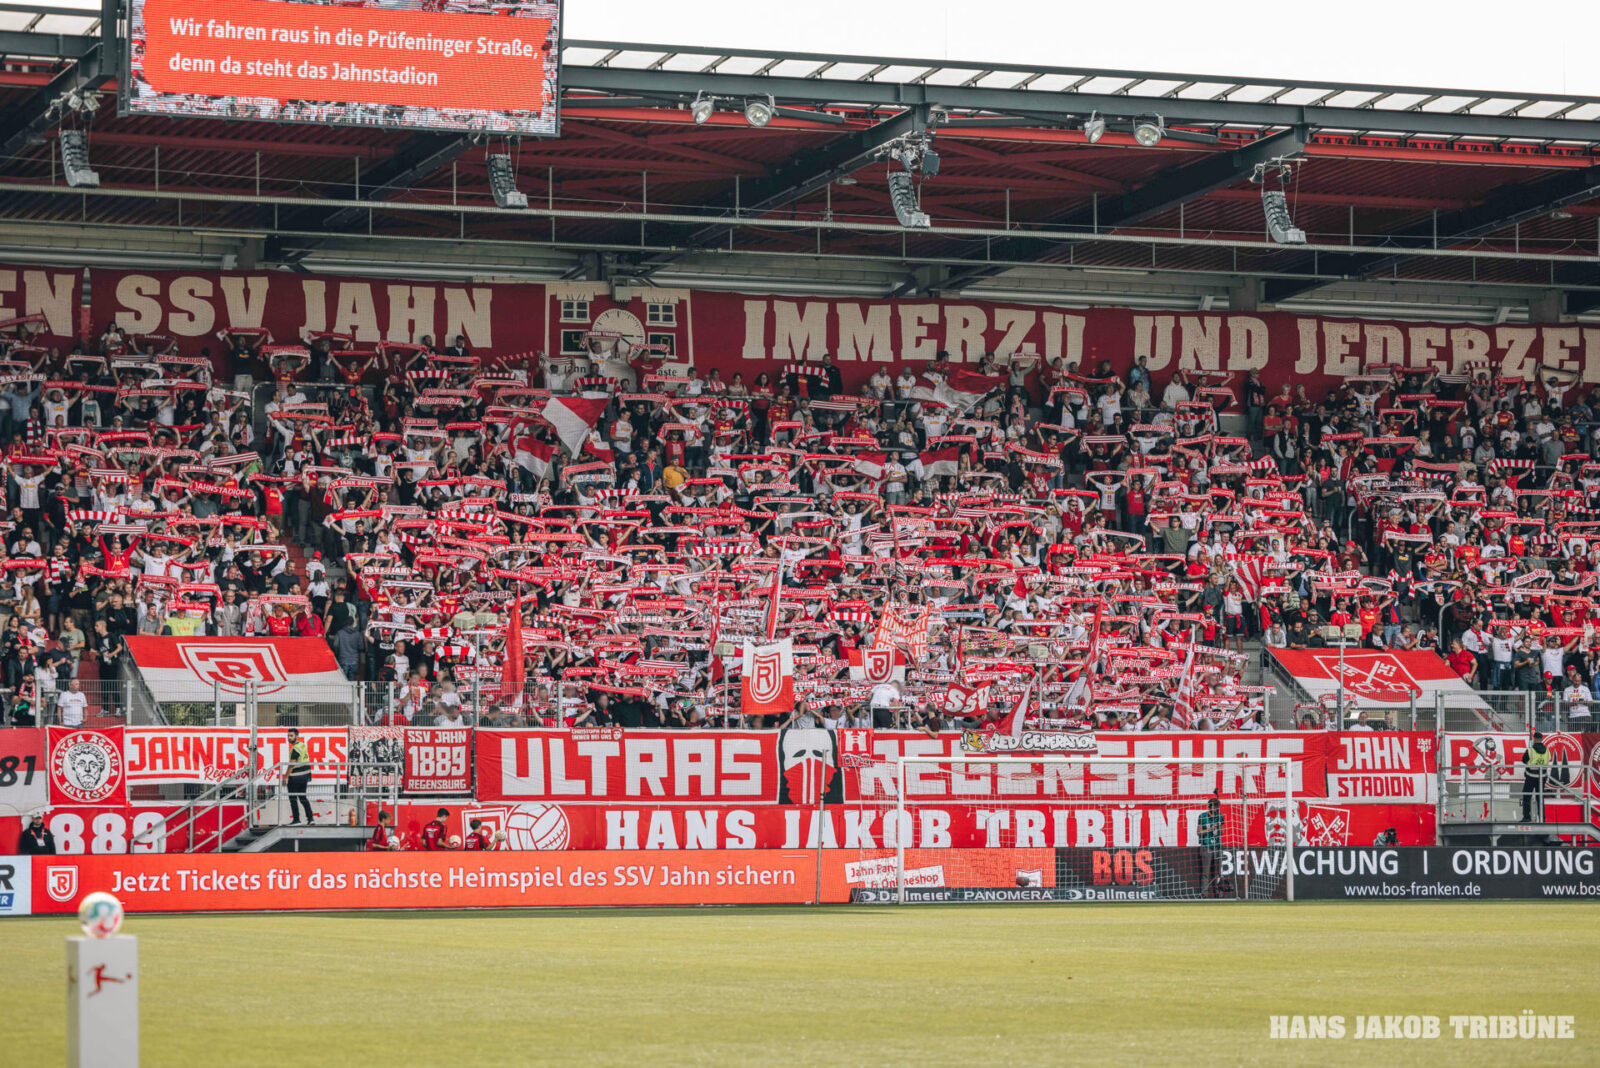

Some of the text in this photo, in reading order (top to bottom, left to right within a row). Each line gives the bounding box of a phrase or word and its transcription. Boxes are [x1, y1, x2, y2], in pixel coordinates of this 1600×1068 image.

[169, 18, 538, 59] Wir fahren raus in die Prüfeninger Straße,
[169, 53, 438, 86] denn da steht das Jahnstadion
[115, 274, 269, 337] SSV
[299, 280, 492, 348] JAHN
[742, 299, 1086, 367] IMMERZU
[1133, 315, 1269, 371] UND
[407, 731, 431, 743] SSV
[434, 731, 467, 743] JAHN
[989, 731, 1097, 751] RED GENERATION
[128, 736, 347, 771] JAHNGSTRS
[408, 746, 466, 776] 1889
[1337, 737, 1410, 770] JAHN
[501, 738, 1304, 796] ULTRAS REGENSBURG
[408, 779, 467, 790] REGENSBURG
[1338, 777, 1414, 797] STADION
[605, 810, 756, 849] HANS
[781, 809, 951, 849] JAKOB
[1221, 850, 1398, 876] BEWACHUNG
[1452, 850, 1594, 875] ORDNUNG
[111, 864, 795, 892] Jetzt Tickets für das nächste Heimspiel des SSV Jahn sichern
[881, 874, 938, 888] Onlneshop
[1344, 881, 1481, 897] www.bos-franken.de
[879, 890, 951, 901] Dalmeier
[964, 890, 1052, 900] PANOMERA
[1086, 889, 1155, 900] Dallmeier
